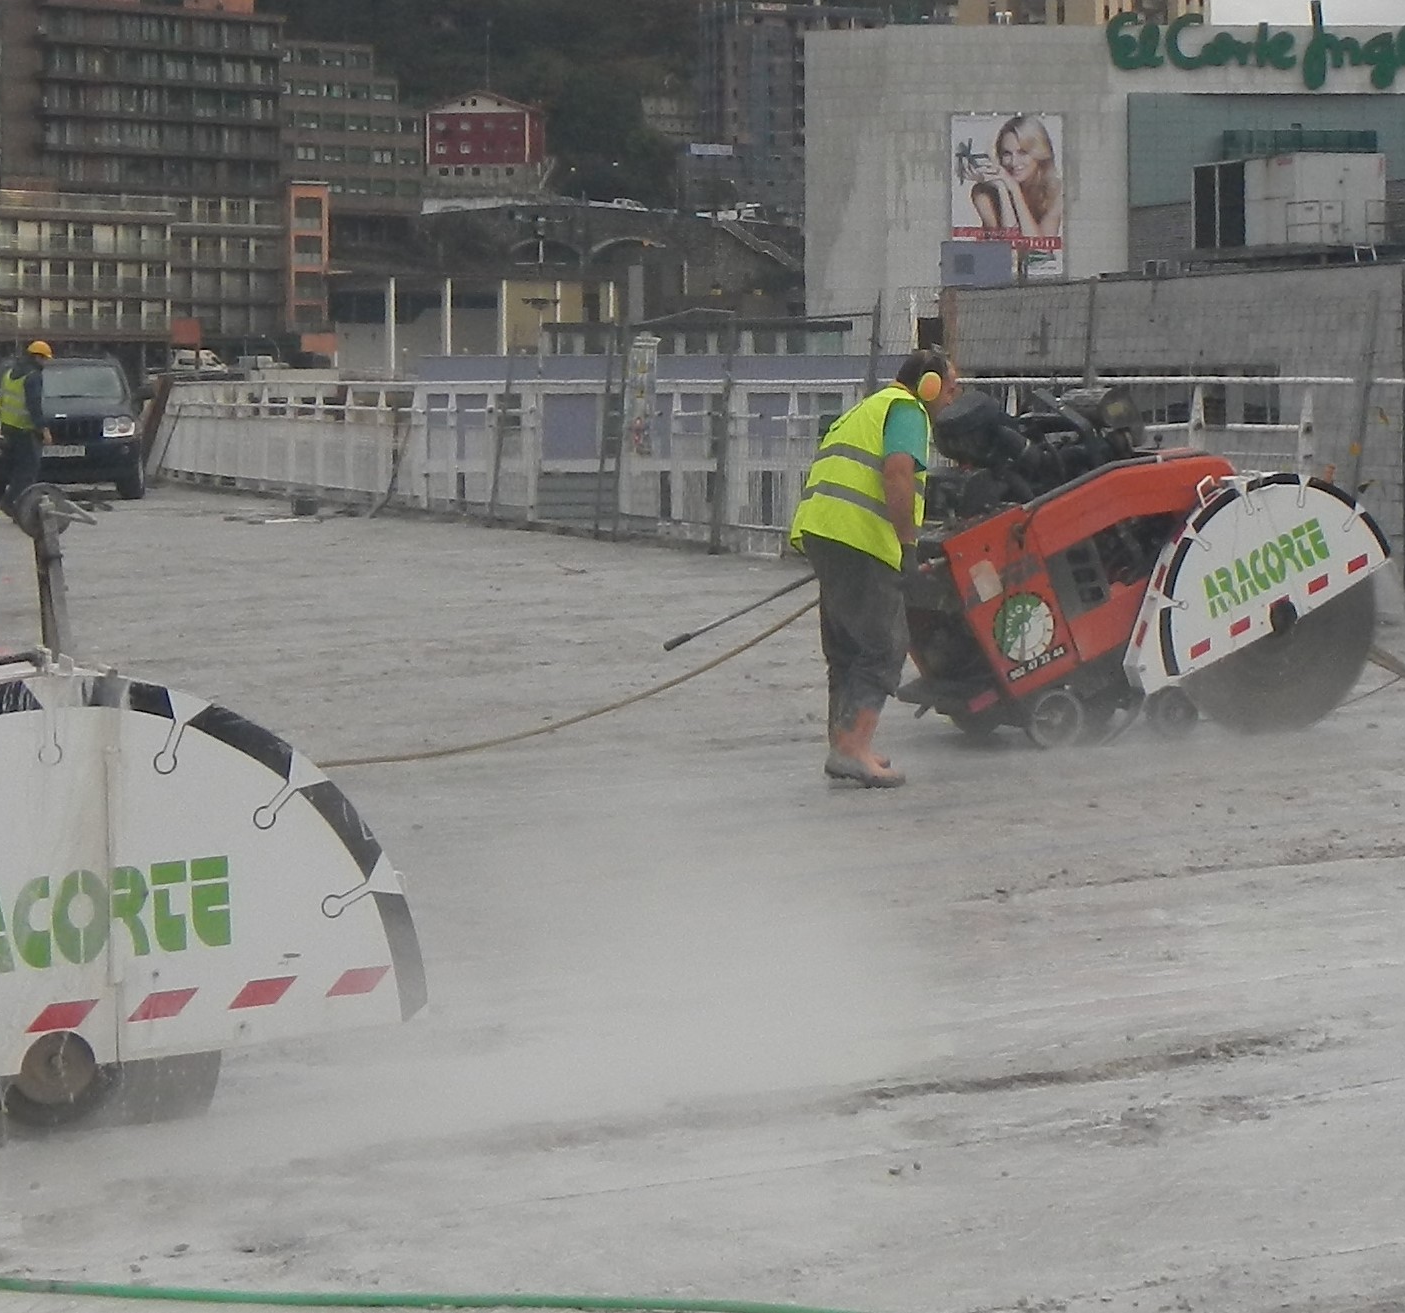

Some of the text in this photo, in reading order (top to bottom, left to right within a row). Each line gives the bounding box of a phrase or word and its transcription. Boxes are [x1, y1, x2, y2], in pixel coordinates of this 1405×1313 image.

[1105, 11, 1164, 70] El
[1166, 12, 1297, 70] Corte
[1203, 517, 1331, 620] ARACORTE
